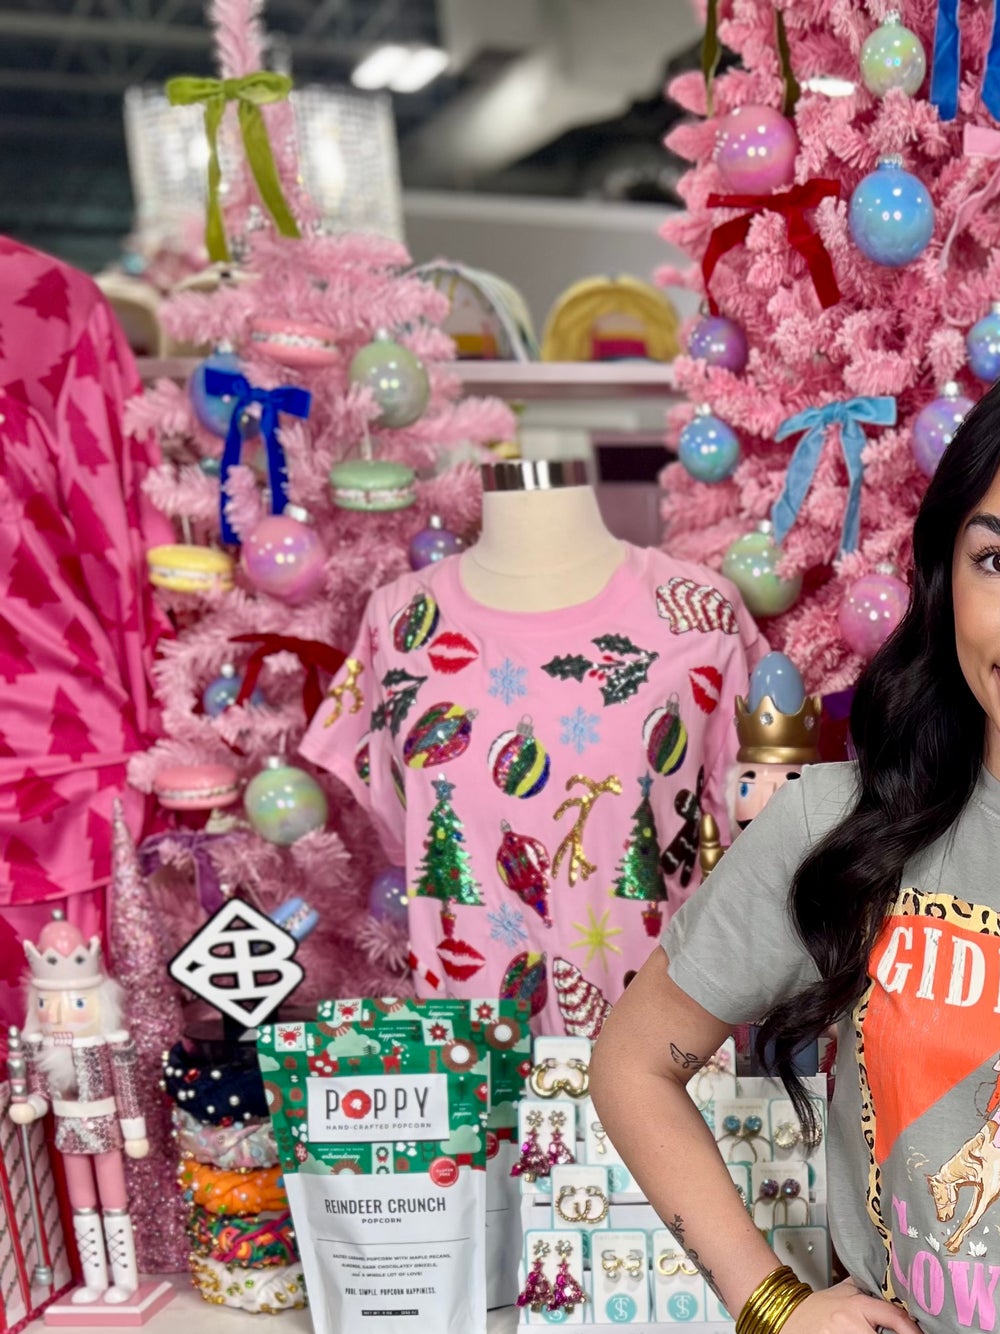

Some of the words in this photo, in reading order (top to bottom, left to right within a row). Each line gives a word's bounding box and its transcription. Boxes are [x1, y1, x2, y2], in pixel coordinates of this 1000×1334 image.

[326, 1123, 389, 1131] HAND-CRAFTED
[324, 1198, 382, 1214] REINDEER
[388, 1197, 446, 1213] CRUNCH
[380, 1288, 405, 1296] POPCORN
